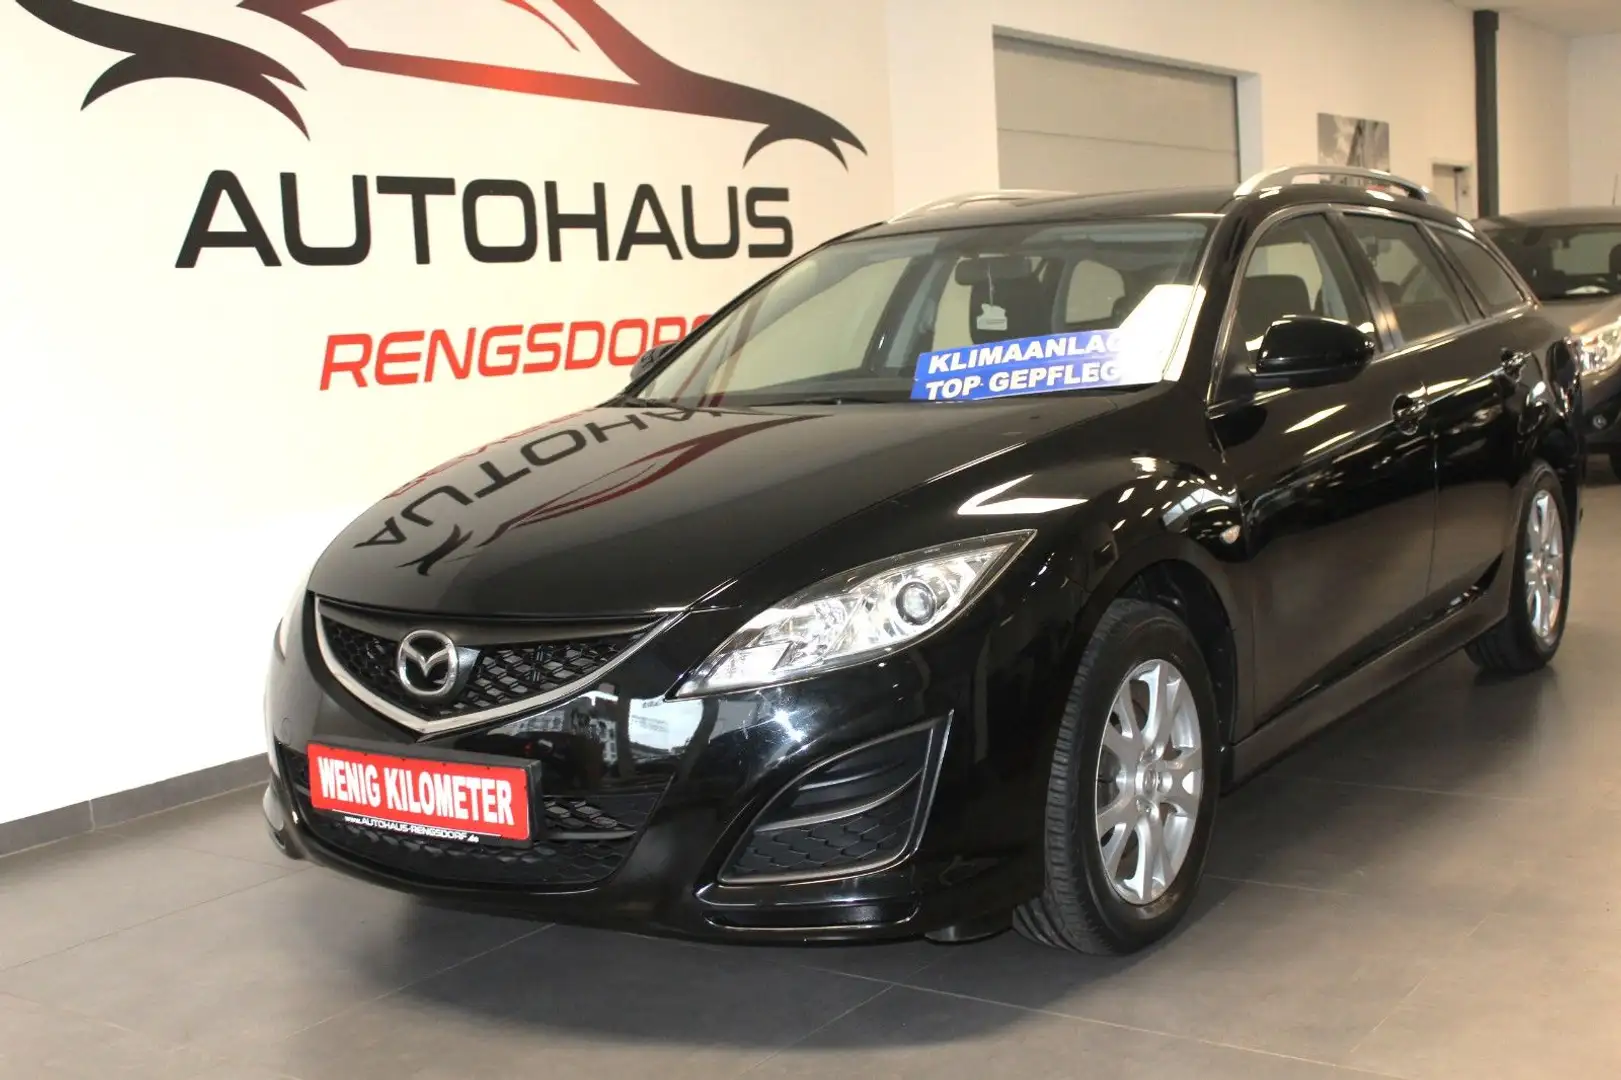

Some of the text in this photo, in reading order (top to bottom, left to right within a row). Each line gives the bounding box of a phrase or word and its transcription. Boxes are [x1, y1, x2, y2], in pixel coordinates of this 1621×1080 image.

[174, 169, 794, 268] AUTOHAUS
[925, 360, 1122, 400] TOP GEPFLEG
[927, 334, 1121, 374] KLIMAANLAG
[317, 756, 515, 826] WENIG KILOMETER
